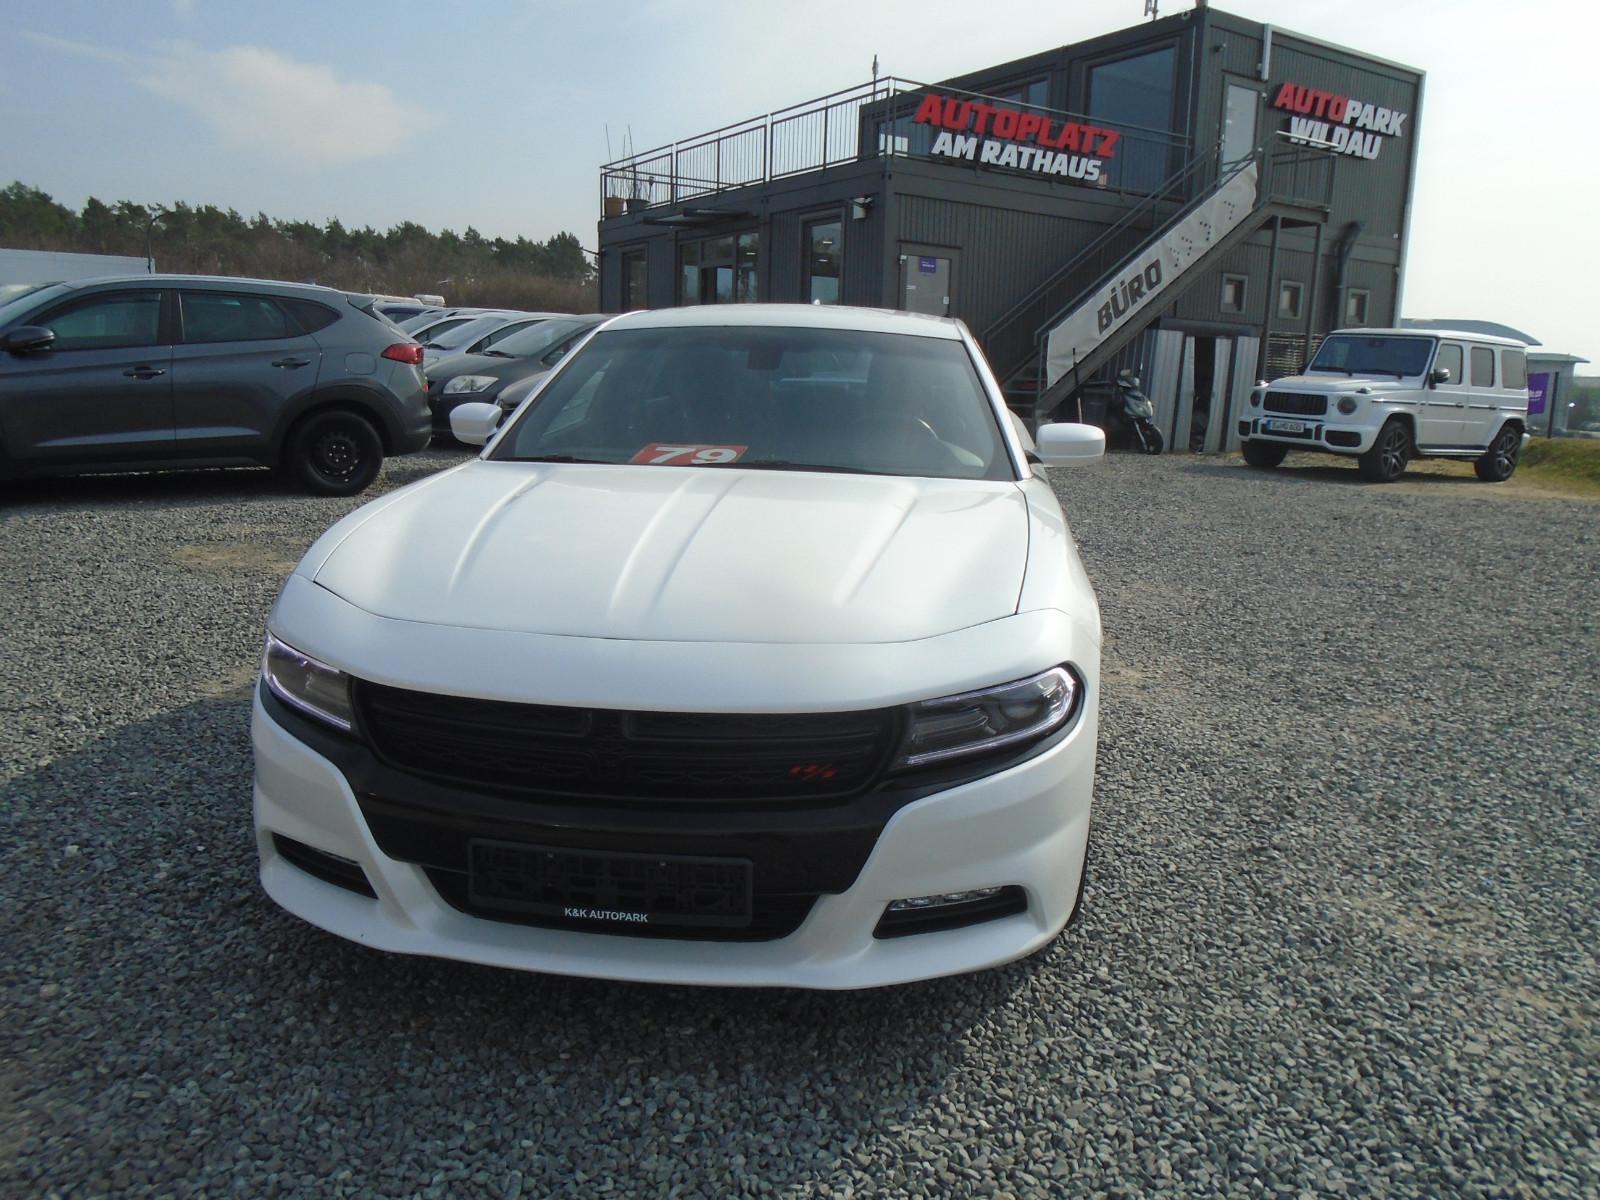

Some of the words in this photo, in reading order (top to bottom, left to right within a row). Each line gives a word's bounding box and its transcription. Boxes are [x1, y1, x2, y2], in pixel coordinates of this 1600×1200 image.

[913, 93, 1121, 159] AUTOPLATZ
[1274, 82, 1407, 137] AUTOPARK
[931, 131, 978, 161] AM
[980, 139, 1102, 181] RATHAUS
[1289, 116, 1384, 160] WILDAU
[1097, 258, 1162, 335] BÜRO
[649, 446, 738, 465] 79
[564, 907, 588, 918] K&K
[589, 909, 648, 922] AUTOPARK
